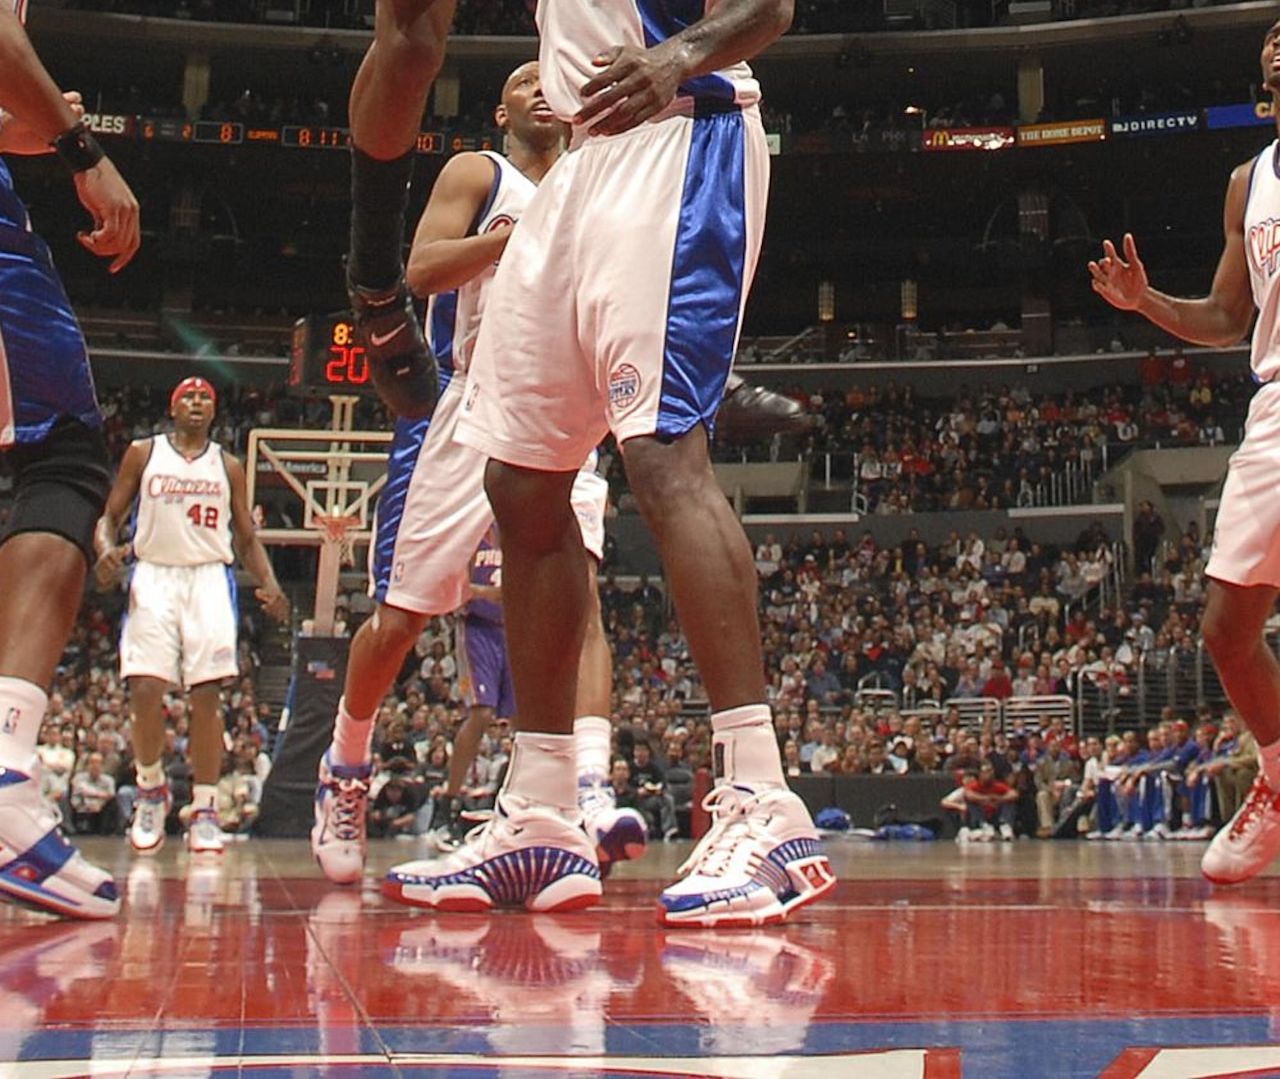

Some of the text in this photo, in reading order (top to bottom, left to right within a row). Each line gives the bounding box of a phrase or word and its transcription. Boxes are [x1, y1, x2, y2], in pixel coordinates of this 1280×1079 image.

[219, 123, 233, 143] 8
[1130, 115, 1198, 131] DIRECTV
[326, 346, 370, 384] 20
[187, 503, 218, 530] 42
